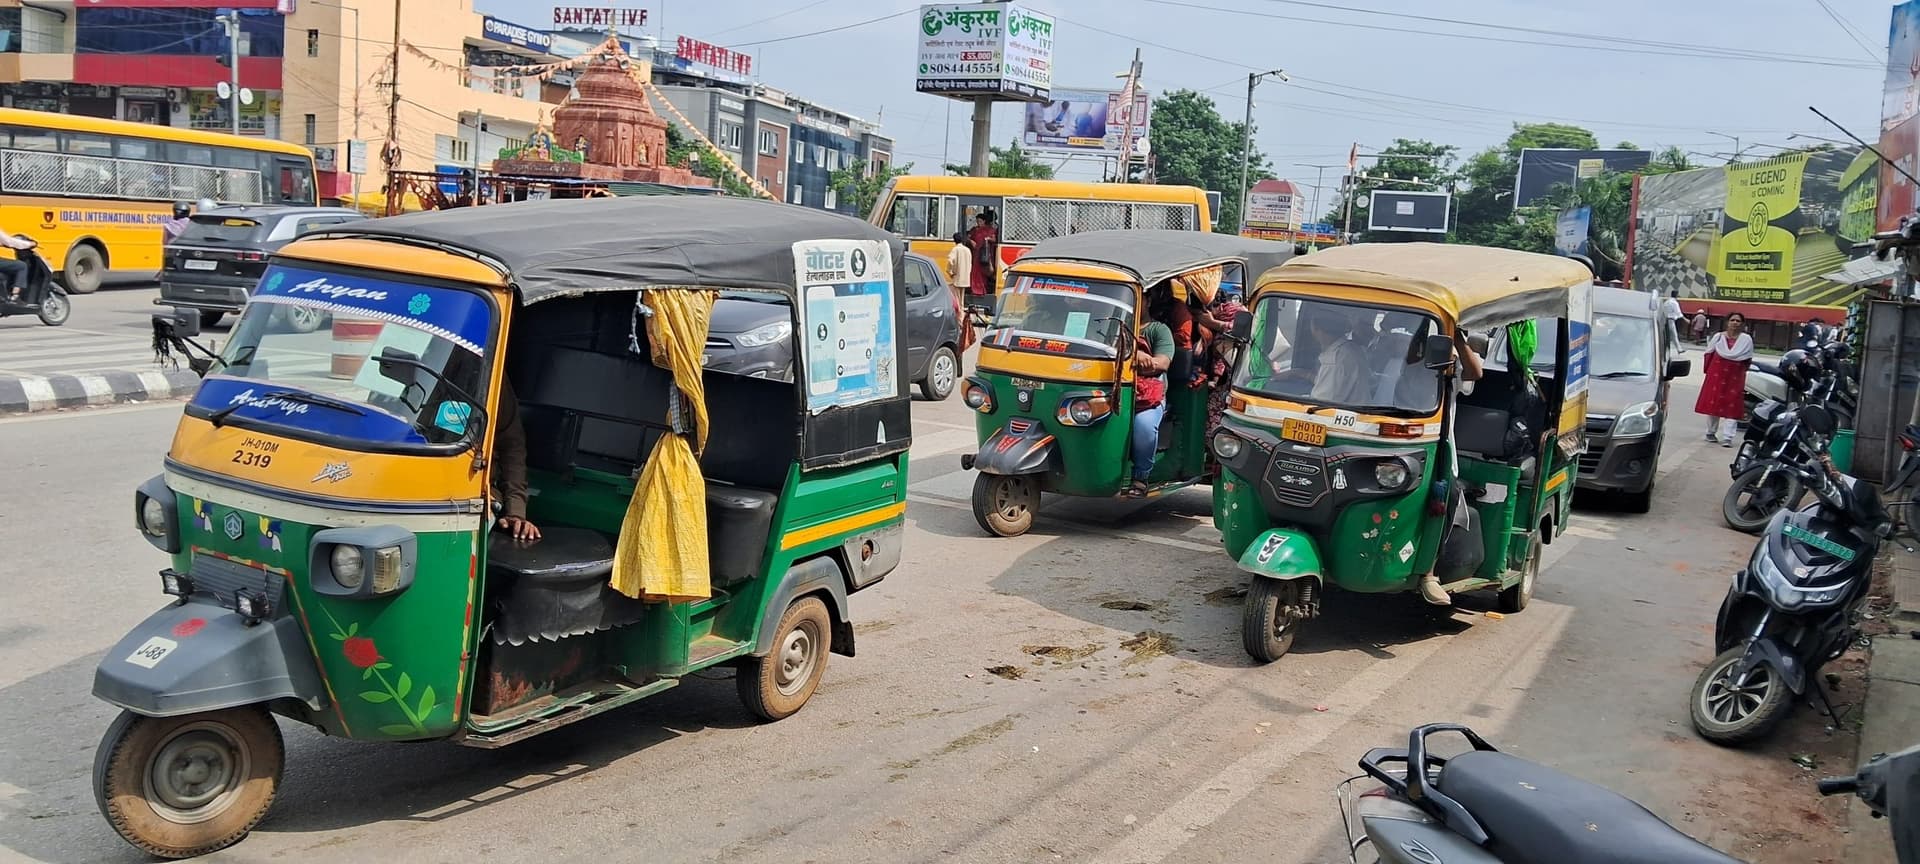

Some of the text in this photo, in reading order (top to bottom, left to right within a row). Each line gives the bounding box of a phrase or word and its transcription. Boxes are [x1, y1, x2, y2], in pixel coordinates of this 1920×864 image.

[622, 9, 647, 25] IVF
[943, 6, 1000, 33] अंकुरम
[1021, 11, 1052, 39] अंकुरम
[494, 21, 527, 41] PARADISE
[979, 28, 1002, 38] IVF
[1039, 38, 1052, 50] IVF
[676, 35, 751, 75] SANTATI IVF
[930, 63, 1000, 74] 8084445554
[1750, 168, 1787, 186] LEGEND
[1757, 185, 1785, 198] COMING
[60, 210, 173, 225] IDEAL INTERNATIONAL SCHOO
[804, 247, 846, 270] वोटर
[288, 277, 390, 301] Aryan
[1292, 421, 1322, 434] JH01D
[241, 436, 280, 453] JH-01DM
[231, 449, 272, 470] 2319
[137, 644, 167, 660] J-88
